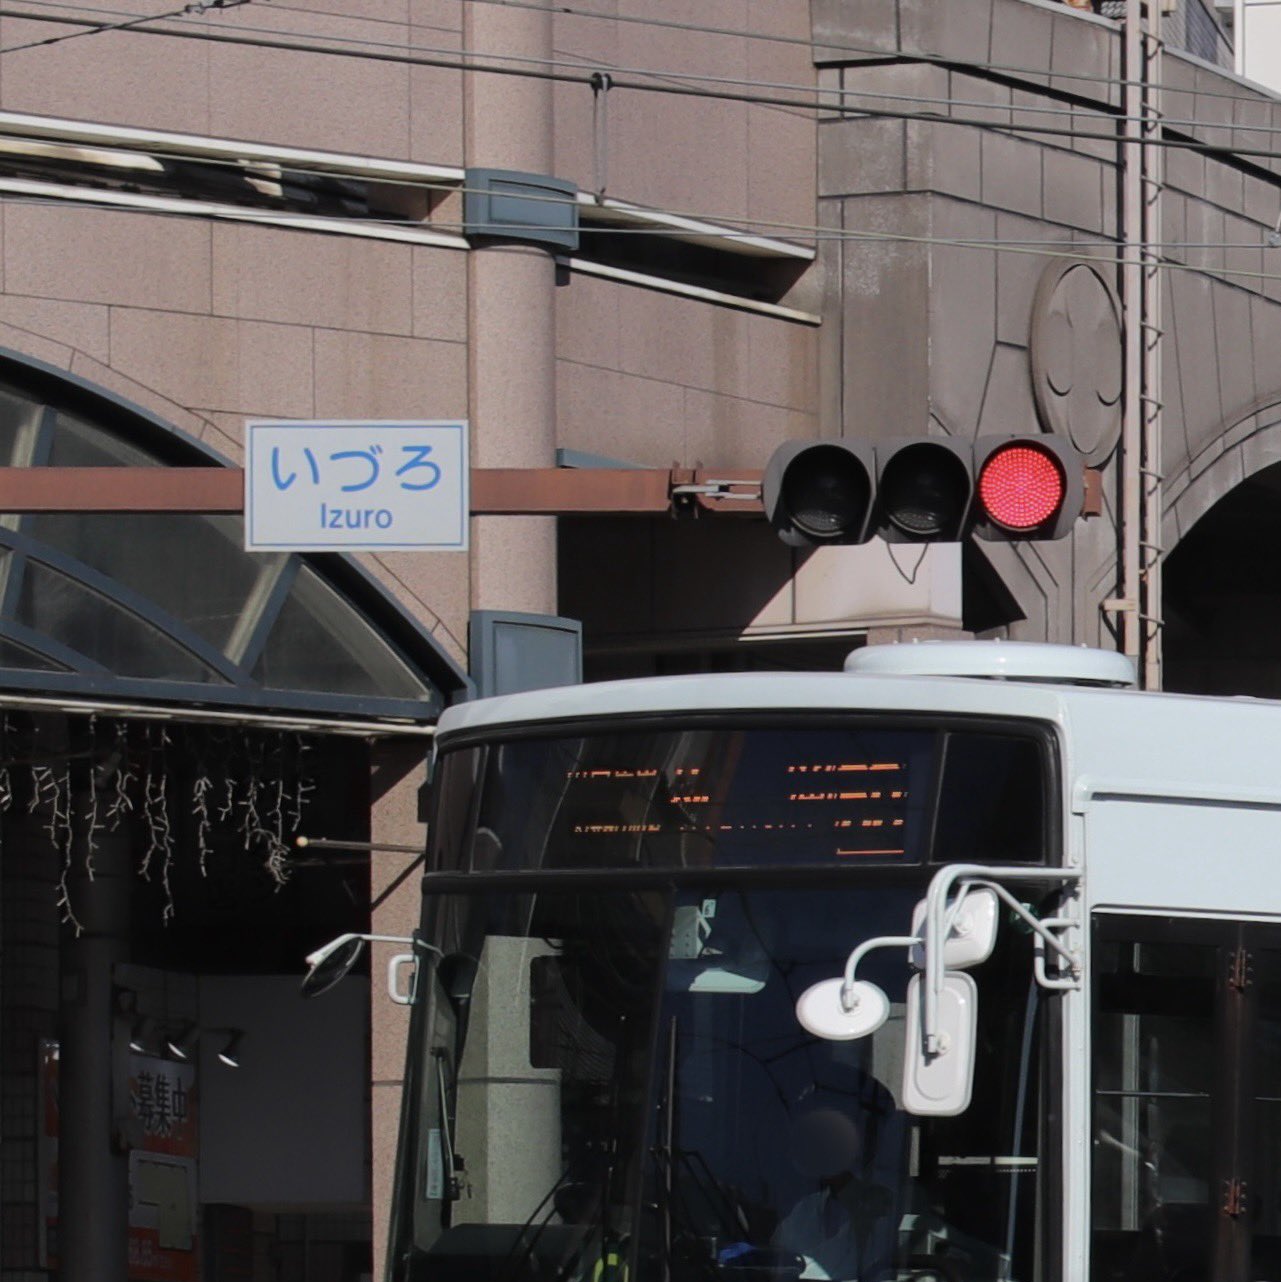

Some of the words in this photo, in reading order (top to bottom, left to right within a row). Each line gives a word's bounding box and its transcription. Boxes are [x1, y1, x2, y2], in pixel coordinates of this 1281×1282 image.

[270, 444, 442, 493] いづろ
[320, 502, 394, 531] Izuro
